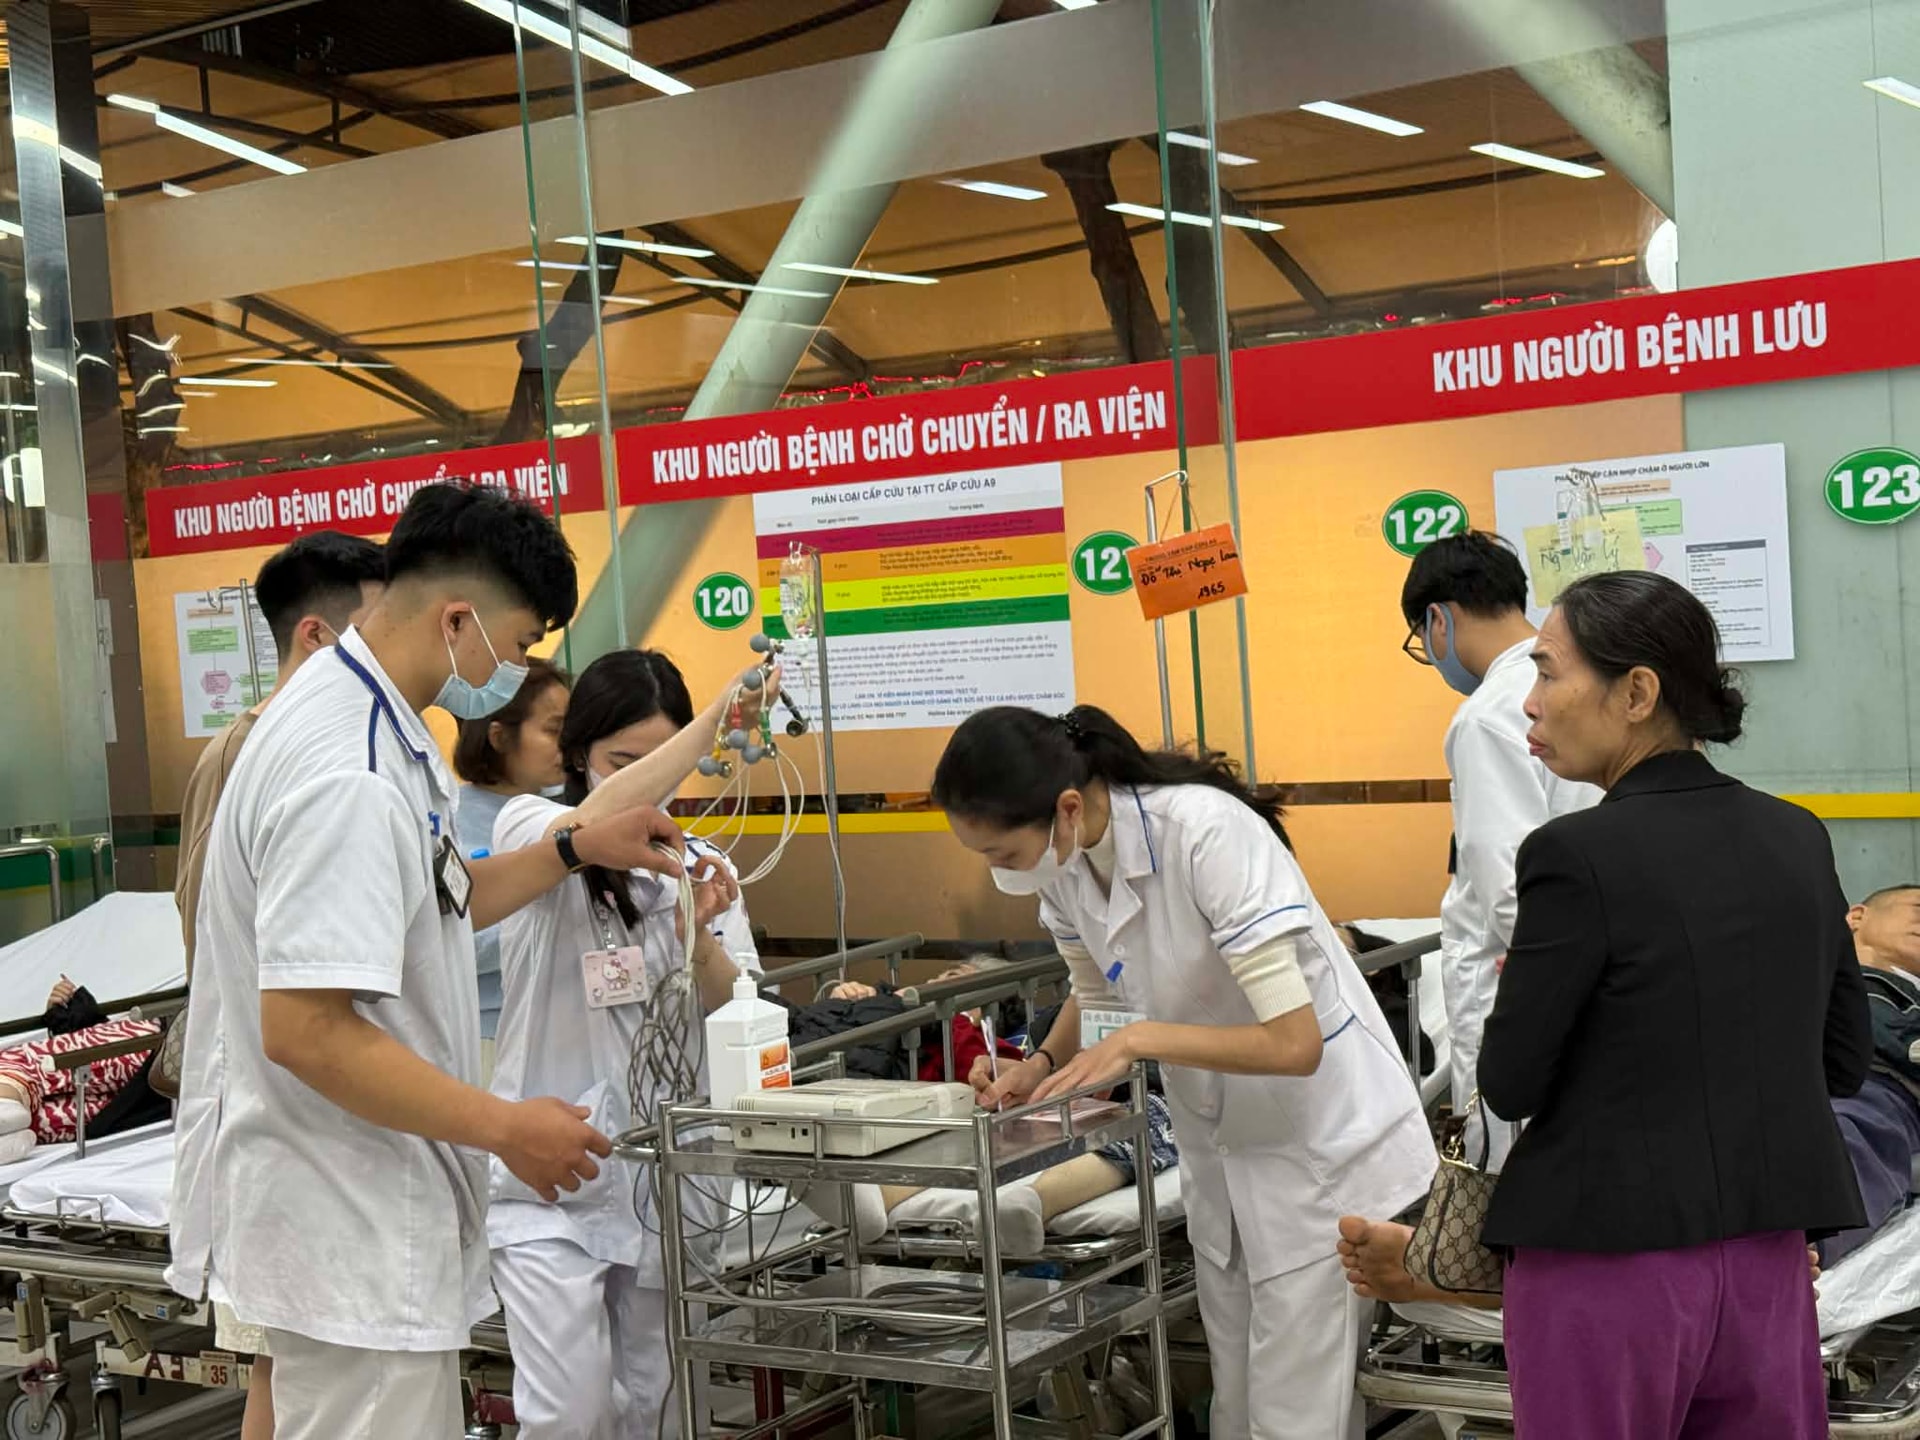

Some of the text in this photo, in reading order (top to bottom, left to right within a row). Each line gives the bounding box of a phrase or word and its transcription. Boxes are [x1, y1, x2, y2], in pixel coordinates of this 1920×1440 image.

[1433, 300, 1828, 393] KHU NGƯỜI BỆNH LƯU
[652, 385, 1167, 484] KHU NGƯỜI BỆNH CHỜ CHUYỂN / RA VIỆN
[174, 505, 212, 539] KHU
[216, 491, 275, 534] NGƯỜI
[278, 488, 332, 532] BỆNH
[336, 478, 377, 520] CHỜ
[513, 457, 569, 505] VIỆN
[923, 484, 936, 495] TT
[983, 477, 997, 489] A9
[1833, 464, 1920, 509] 123
[1389, 505, 1461, 545] 122
[1081, 546, 1131, 581] 12
[698, 585, 749, 617] 120
[1197, 581, 1226, 600] 1965
[210, 1364, 228, 1385] 35
